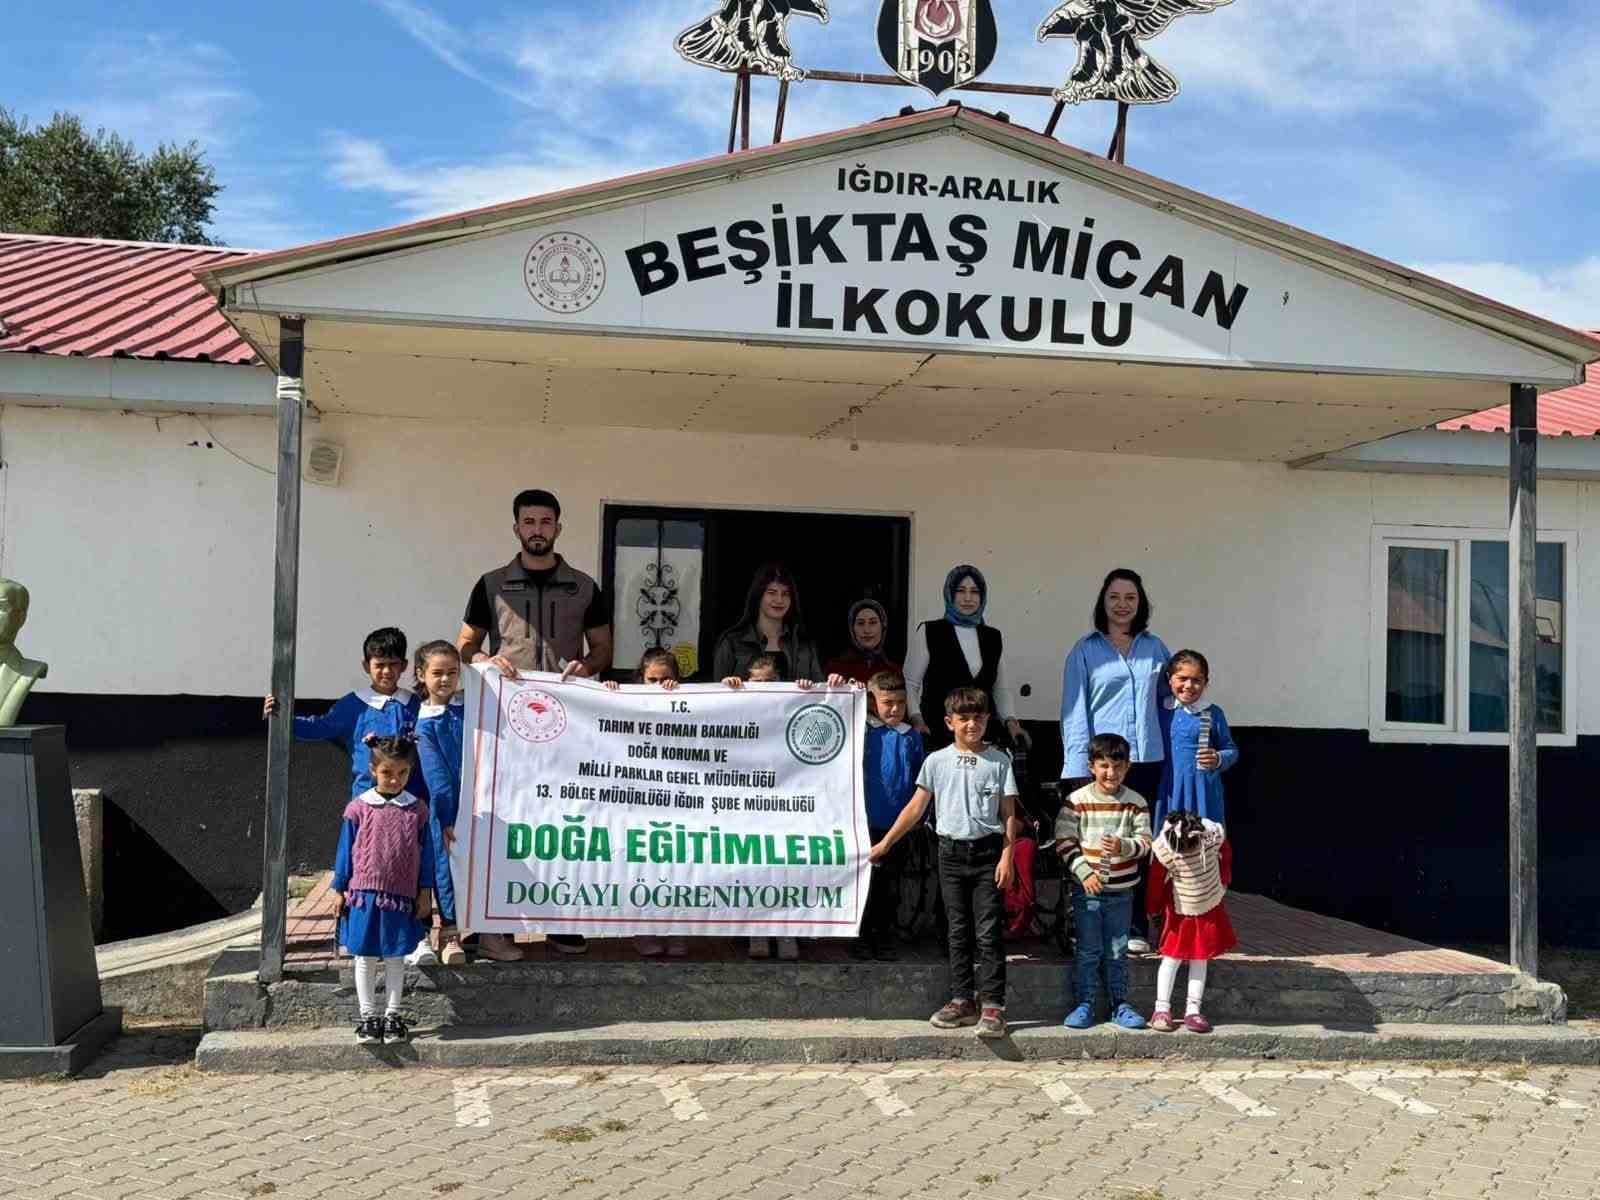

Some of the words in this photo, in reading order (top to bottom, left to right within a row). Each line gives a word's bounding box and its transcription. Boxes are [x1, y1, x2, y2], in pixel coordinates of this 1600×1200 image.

[905, 48, 972, 75] 1903
[837, 163, 1063, 205] IĞDIR-ARALIK
[624, 203, 989, 297] BEŞİKTAŞ
[1012, 217, 1249, 330] MİCAN
[776, 271, 1133, 348] İLKOKULU
[670, 701, 691, 713] T.C.
[598, 719, 635, 735] TARIM
[638, 722, 653, 735] VE
[655, 723, 697, 738] ORMAN
[701, 721, 760, 740] BAKANLIĞI
[628, 742, 657, 760] DOĞA
[661, 745, 710, 762] KORUMA
[713, 749, 728, 763] VE
[578, 759, 611, 778] MİLLİ
[614, 765, 663, 782] PARKLAR
[666, 771, 701, 785] GENEL
[704, 769, 776, 788] MÜDÜRLÜĞÜ
[536, 784, 553, 799] 13.
[560, 782, 596, 801] BÖLGE
[599, 785, 671, 807] MÜDÜRLÜĞÜ
[674, 791, 705, 809] IĞDIR
[711, 796, 741, 814] ŞUBE
[744, 794, 815, 813] MÜDÜRLÜĞÜ
[506, 815, 612, 862] DOĞA
[626, 820, 846, 865] EĞİTİMLERİ
[506, 876, 620, 906] DOĞAYI
[629, 877, 844, 909] ÖĞRENİYORUM
